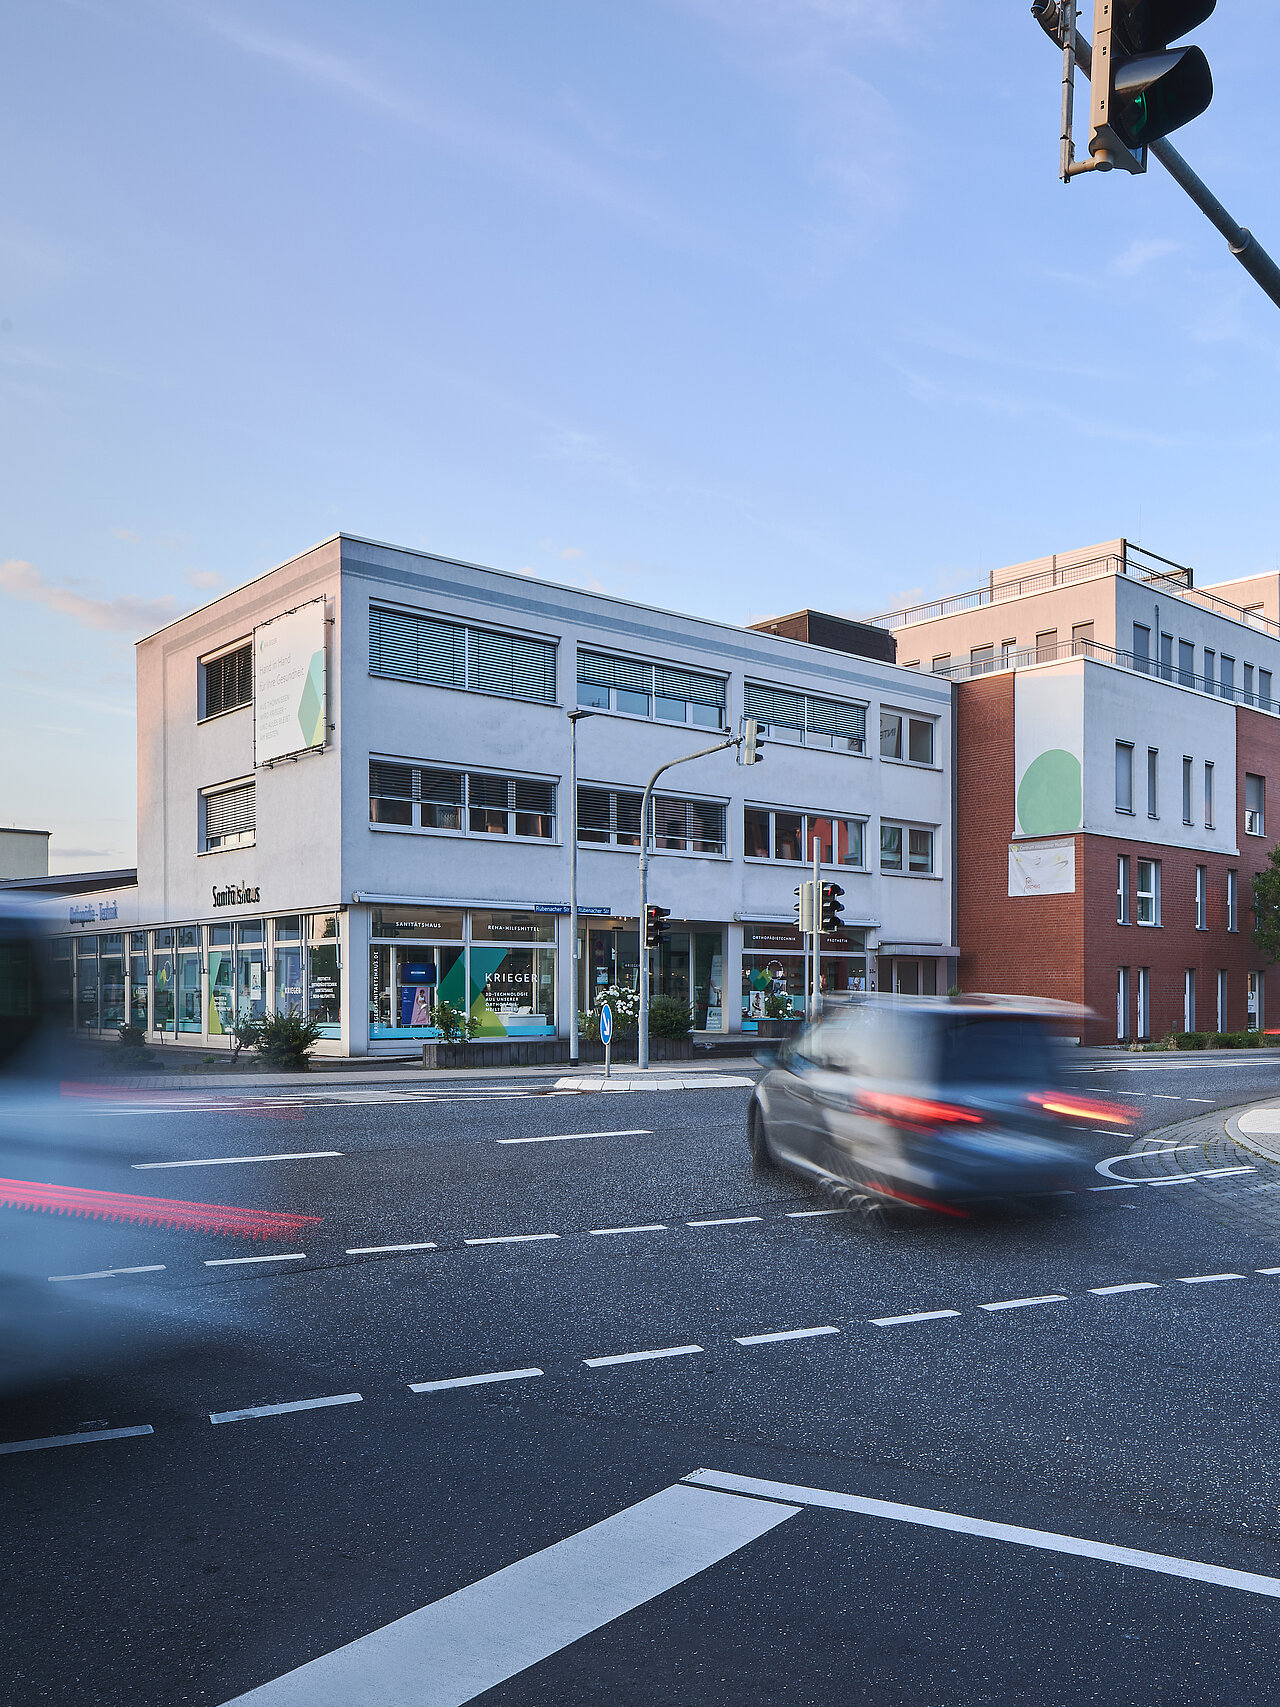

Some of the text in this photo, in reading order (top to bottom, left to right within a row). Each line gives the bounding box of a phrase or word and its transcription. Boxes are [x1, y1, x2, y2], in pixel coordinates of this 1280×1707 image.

[212, 879, 261, 907] Sanitätshaus
[535, 904, 562, 912] Rübenacher
[395, 920, 442, 929] SANITÄTSHAUS
[485, 972, 538, 983] KRIEGER
